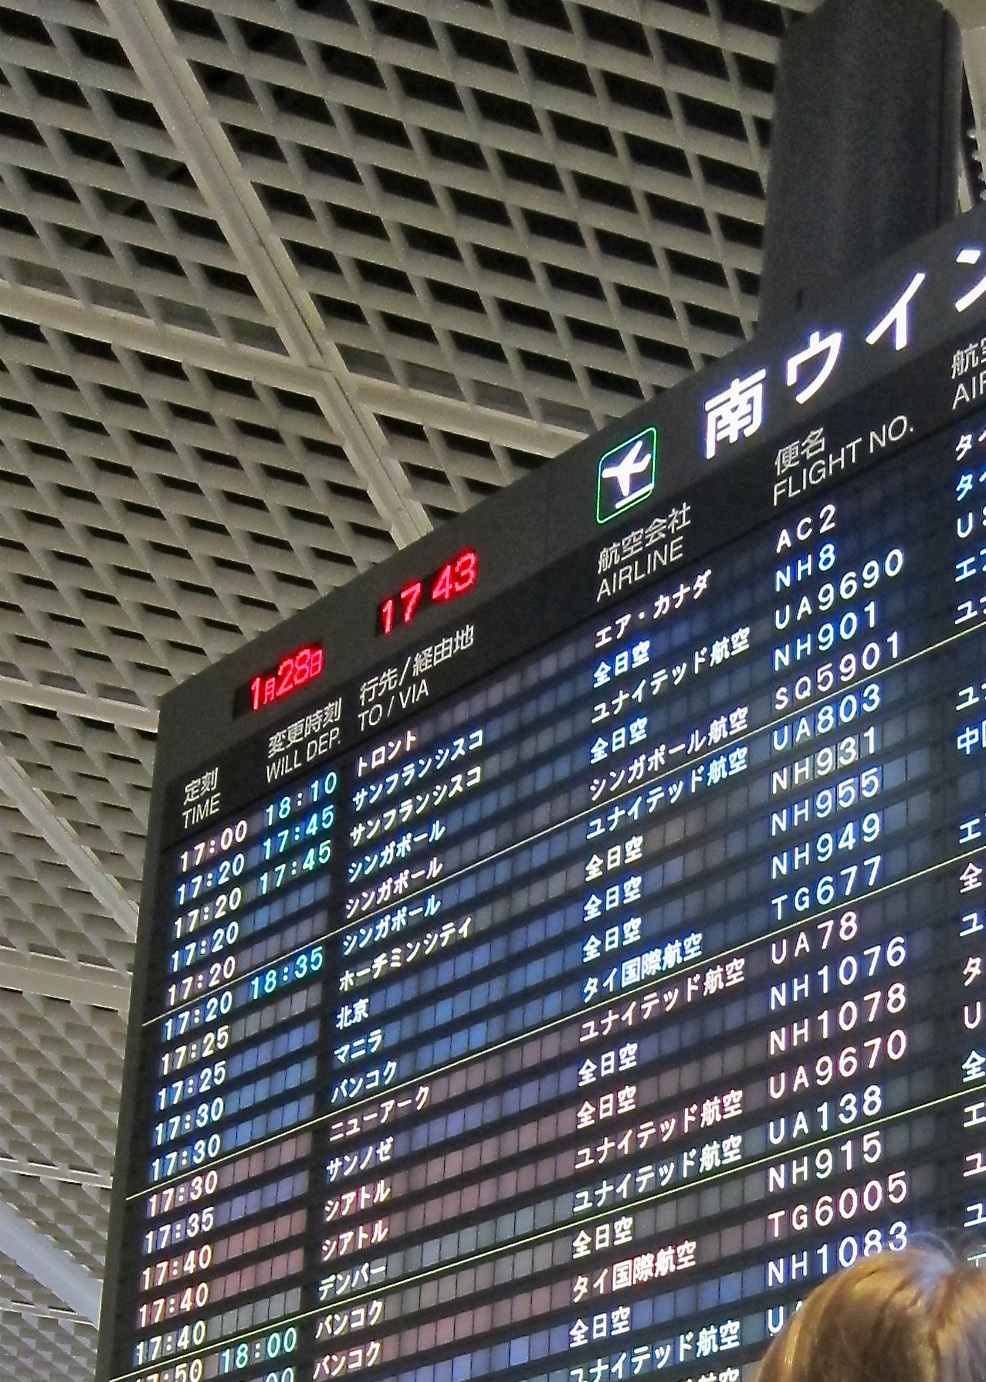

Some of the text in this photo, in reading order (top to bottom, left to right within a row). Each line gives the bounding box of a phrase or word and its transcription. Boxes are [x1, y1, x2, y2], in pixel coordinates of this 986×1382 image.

[773, 415, 914, 506] FLIGHT NO.
[774, 427, 825, 475] 便名
[597, 502, 691, 574] 航空会社
[775, 503, 836, 554] AC2
[596, 535, 683, 602] AIRLINE
[774, 548, 904, 630] UA9690
[775, 543, 836, 592] NH8
[594, 568, 712, 649] エア・カナダ
[773, 600, 875, 672] NH901
[250, 647, 324, 712] 1月28日
[359, 624, 474, 706] 行先/経由地
[590, 626, 750, 724] ユナイテッド航空
[774, 631, 898, 710] SQ5901
[267, 697, 342, 758] 変更時刻
[357, 703, 383, 731] TO
[399, 678, 429, 708] VIA
[772, 682, 881, 751] UA803
[266, 726, 340, 783] WILL DEP.
[351, 728, 484, 812] サンフランシスコ
[357, 729, 417, 778] トロント
[589, 705, 748, 801] シンガポール航空
[181, 792, 221, 829] TIME
[183, 766, 218, 805] 定刻
[265, 770, 337, 826] 18:10
[585, 746, 748, 840] ユナイテッド航空
[771, 766, 880, 837] NH955
[179, 819, 248, 872] 17:00
[262, 803, 334, 860] 17:45
[347, 819, 446, 883] シンガポール
[771, 812, 880, 880] NH949
[177, 852, 245, 905] 17:20
[259, 838, 331, 895] 17:45
[345, 856, 443, 919] シンガポール
[771, 854, 881, 921] TG677
[582, 916, 642, 963] 全日空
[771, 910, 858, 965] UA78
[250, 945, 323, 1000] 18:35
[582, 932, 703, 1003] タイ国際航空
[770, 935, 906, 1011] NH1076
[164, 990, 233, 1041] 17:20
[335, 997, 370, 1030] 北京
[160, 1024, 229, 1076] 17:25
[333, 1028, 383, 1064] マニラ
[577, 1041, 638, 1087] 全日空
[769, 1028, 907, 1099] UA9670
[330, 1060, 397, 1103] バンコク
[154, 1096, 224, 1146] 17:30
[329, 1085, 430, 1142] ニューアーク
[574, 1089, 743, 1169] ユナイテッド航空
[768, 1084, 883, 1145] UA138
[325, 1135, 394, 1182] サンノゼ
[148, 1169, 218, 1218] 17:30
[324, 1178, 391, 1222] シアトル
[767, 1170, 907, 1238] TG6005
[144, 1206, 214, 1254] 17:35
[317, 1262, 386, 1301] デンバー
[573, 1240, 697, 1303] タイ国際航空
[138, 1281, 209, 1328] 17:40
[221, 1326, 297, 1374] 18:00
